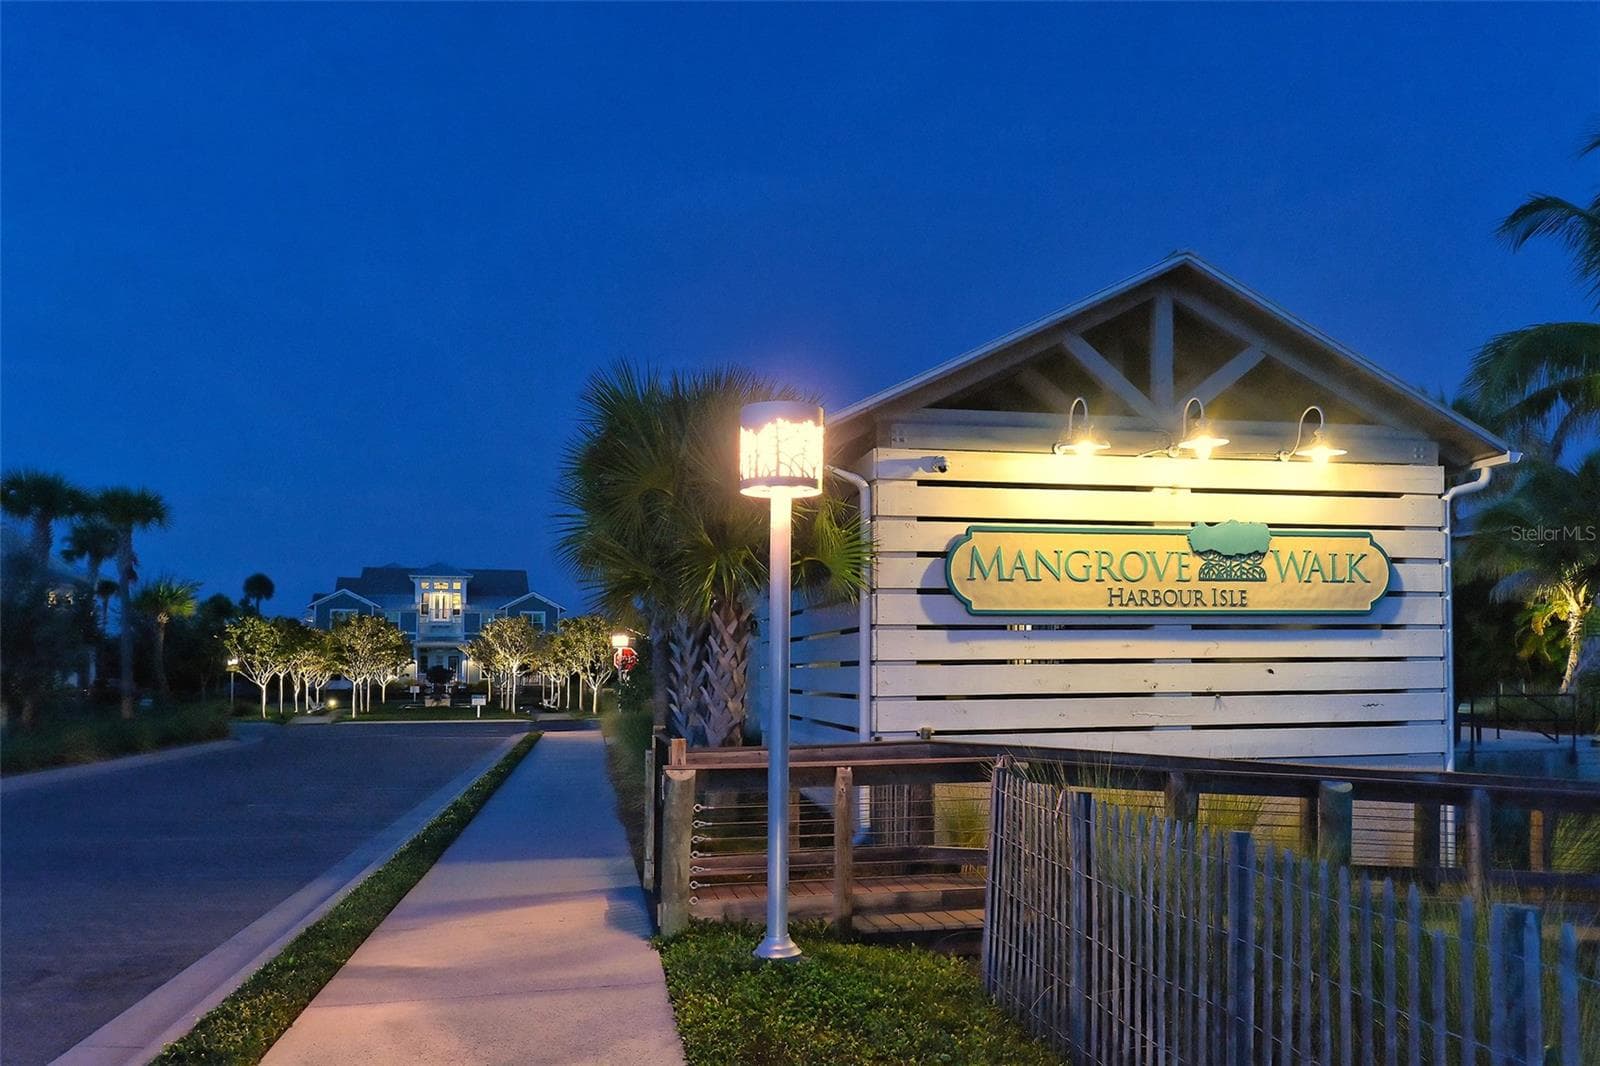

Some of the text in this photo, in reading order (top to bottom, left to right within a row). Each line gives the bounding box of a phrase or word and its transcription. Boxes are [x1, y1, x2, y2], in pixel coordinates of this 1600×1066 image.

[967, 545, 1371, 584] MANGROVE WALK
[1107, 588, 1249, 607] HARBOUR ISLE
